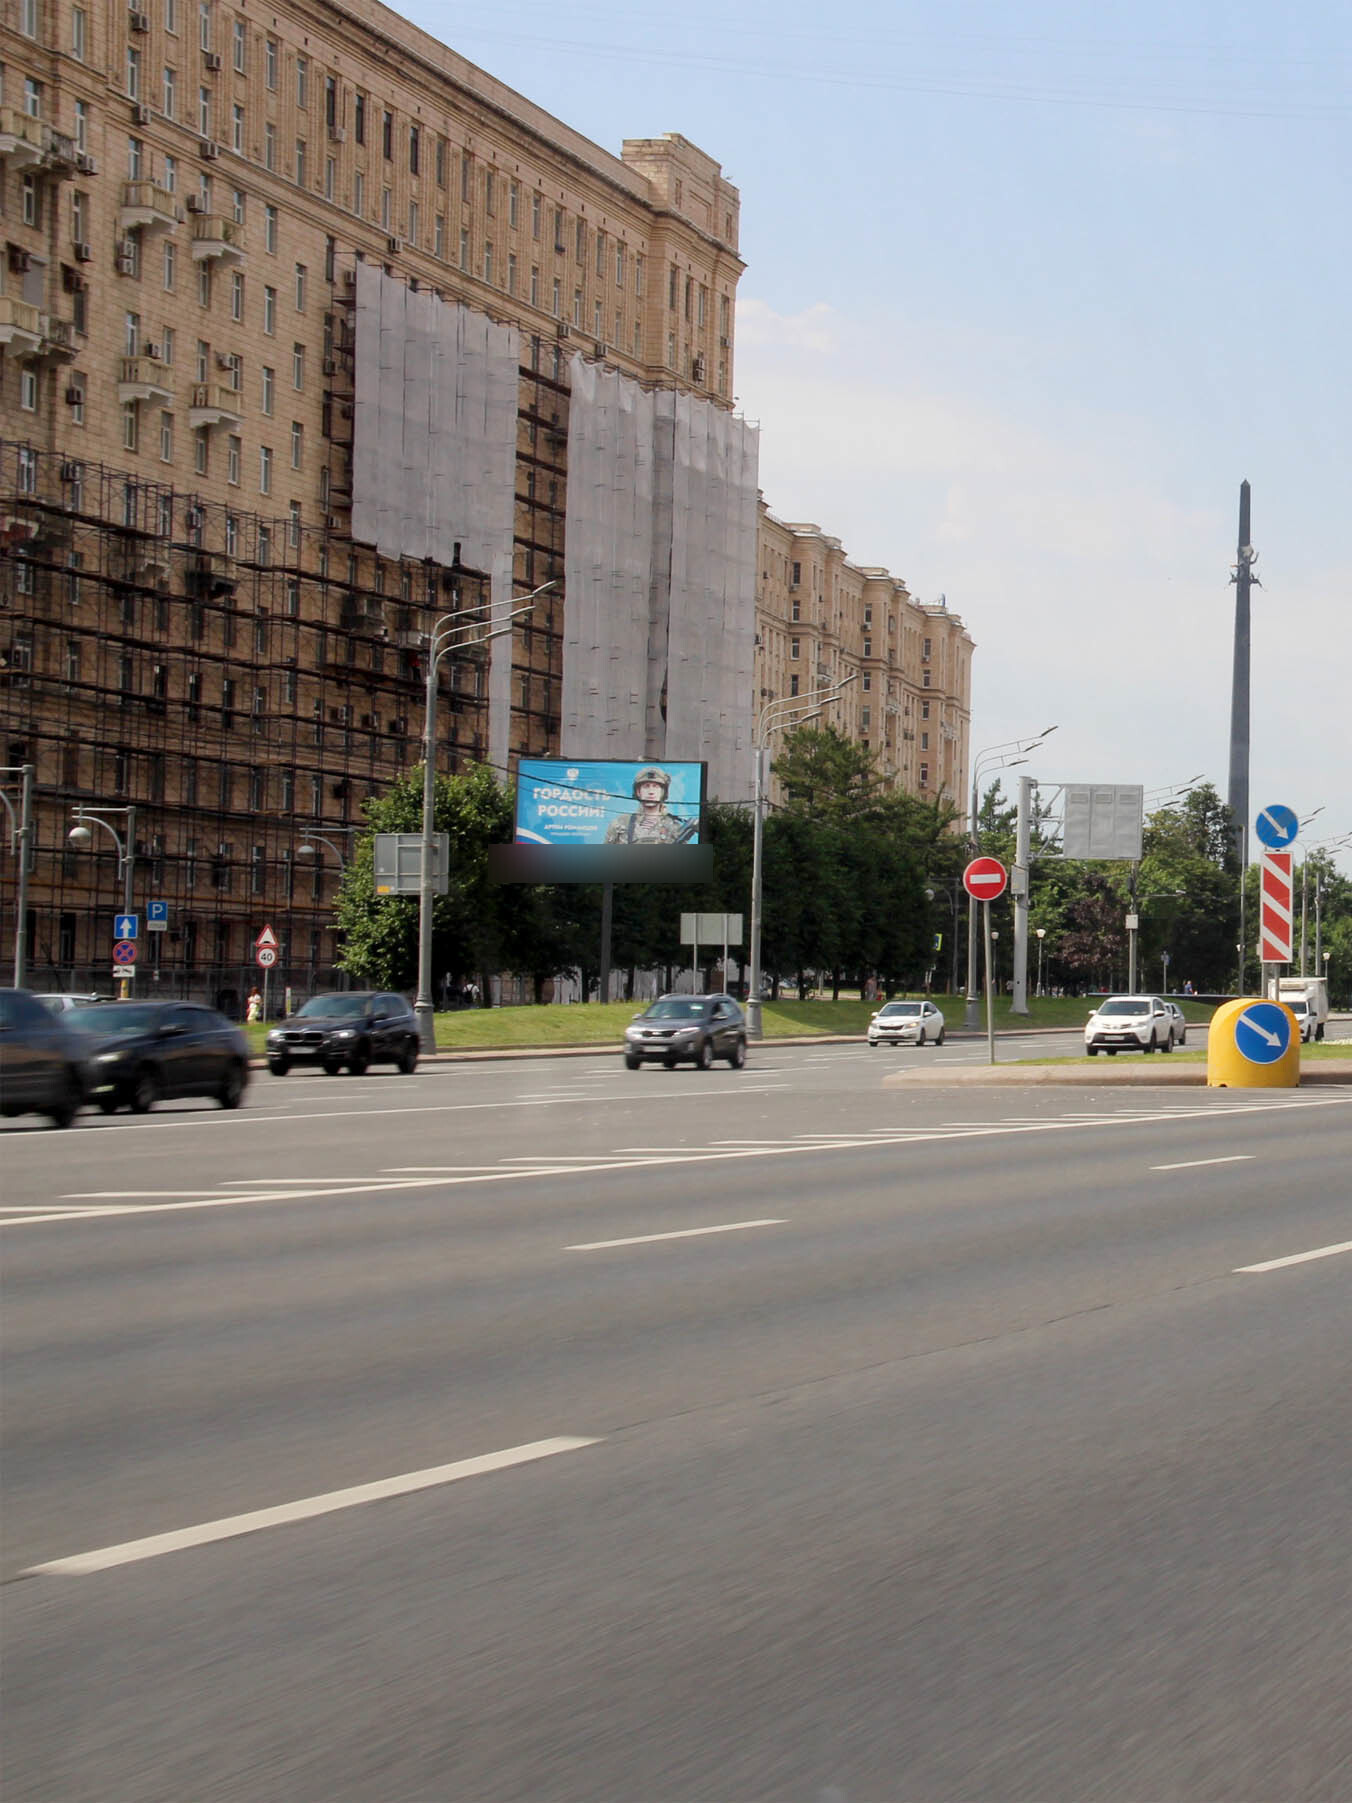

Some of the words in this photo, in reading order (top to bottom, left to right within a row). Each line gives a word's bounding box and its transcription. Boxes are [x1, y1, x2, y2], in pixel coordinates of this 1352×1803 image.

[533, 788, 610, 801] ГОРДОСТЬ
[538, 805, 605, 817] РОССИИ!
[152, 904, 163, 918] P
[260, 952, 273, 962] 40
